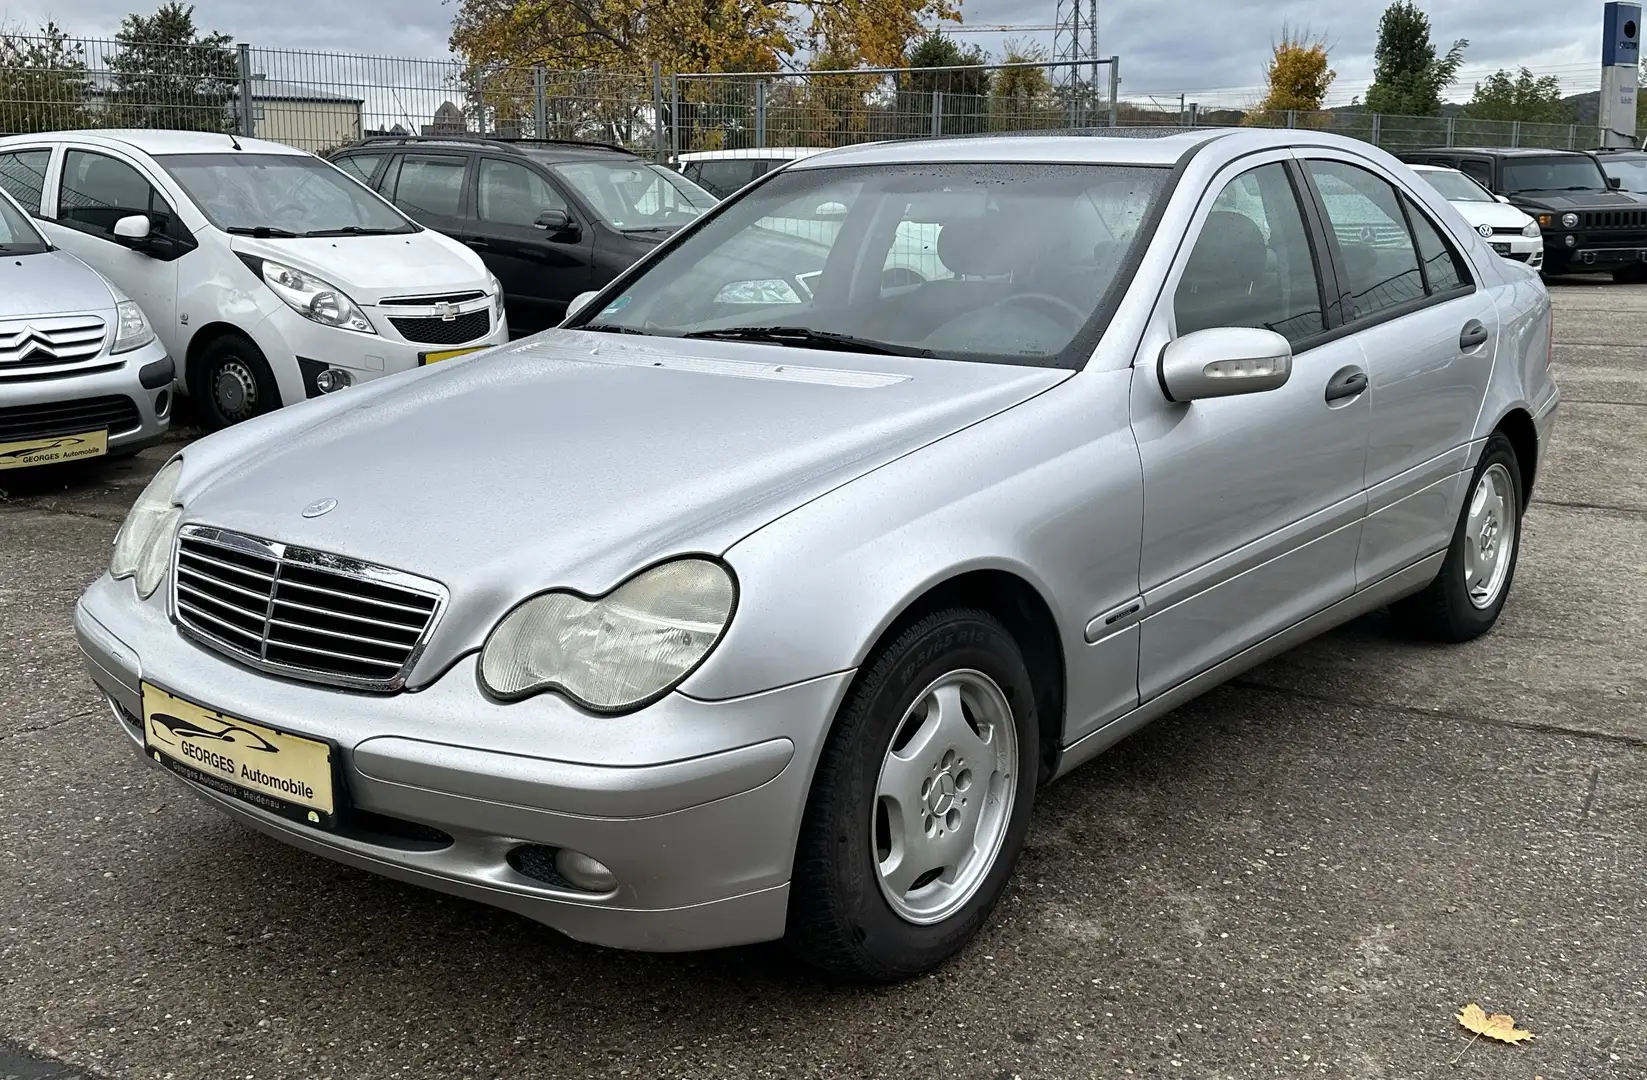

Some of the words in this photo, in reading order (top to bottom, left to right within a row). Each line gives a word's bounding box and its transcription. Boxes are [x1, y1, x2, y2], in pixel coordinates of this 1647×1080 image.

[23, 453, 60, 463] GEORGES
[62, 447, 100, 459] Automobile
[181, 741, 235, 774] GEORGES
[241, 764, 313, 799] Automobile
[243, 789, 280, 809] Heidenau
